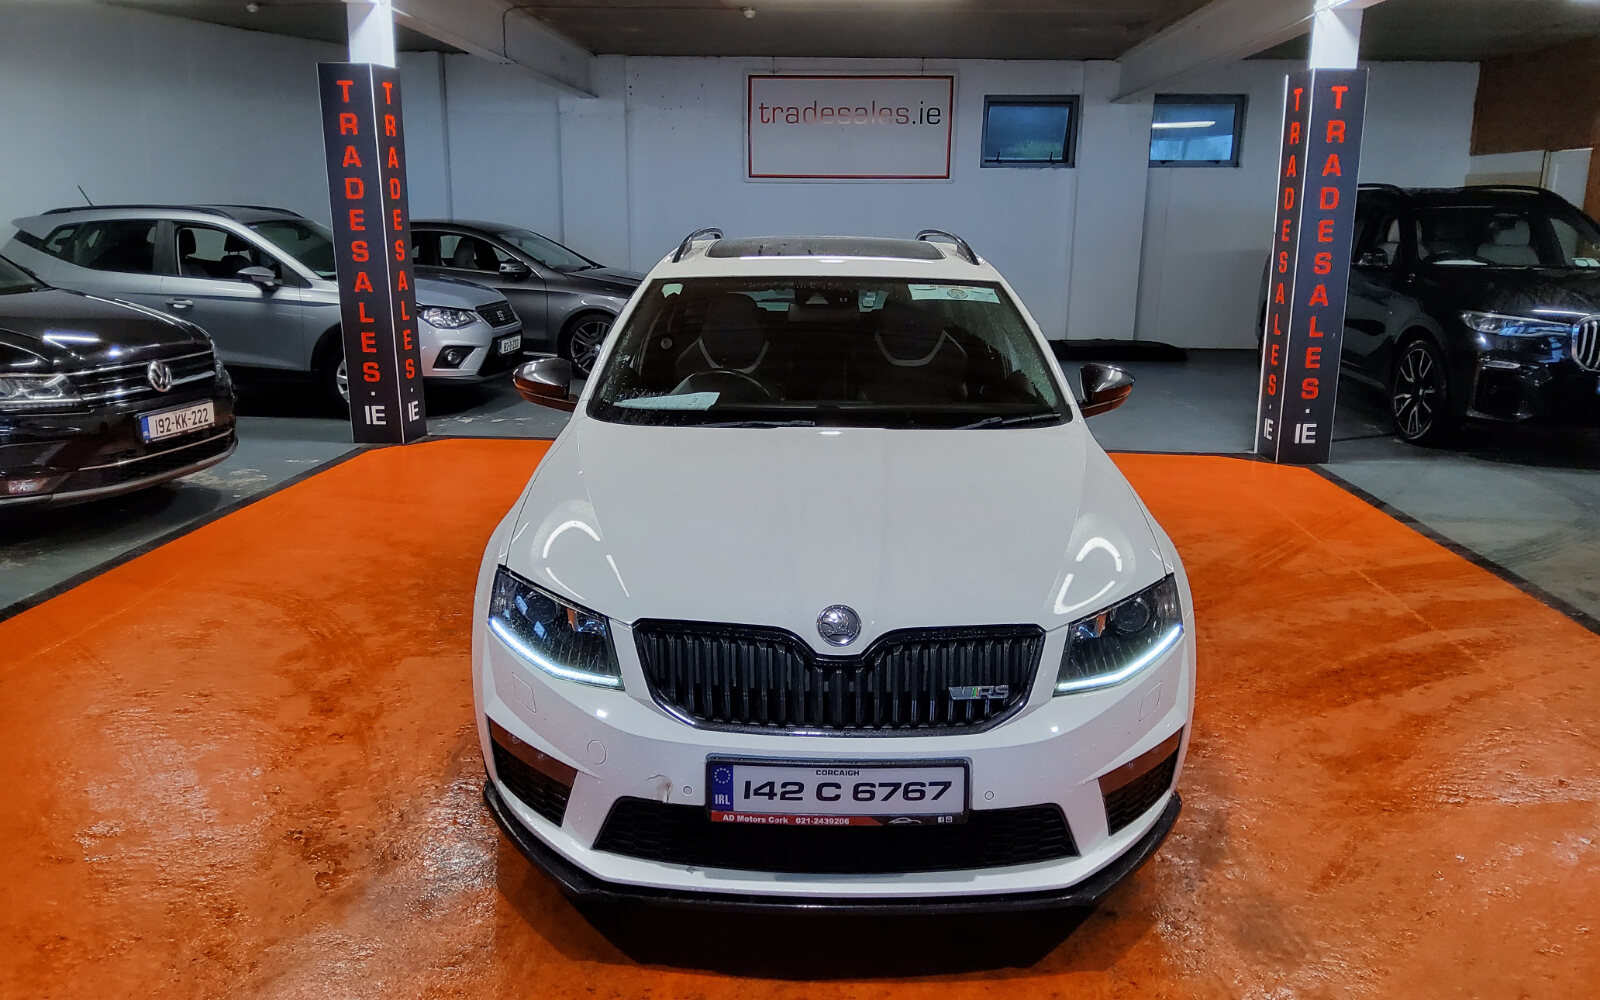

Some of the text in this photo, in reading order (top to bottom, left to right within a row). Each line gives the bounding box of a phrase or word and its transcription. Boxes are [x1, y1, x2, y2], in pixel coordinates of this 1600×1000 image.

[758, 100, 942, 125] tradesales.ie
[154, 407, 209, 436] 192-KK-222
[815, 769, 860, 777] CORCAIGH
[714, 793, 731, 806] IRL
[743, 780, 953, 802] 142 C 6767
[722, 814, 735, 822] AD
[736, 815, 766, 824] Motors
[768, 816, 789, 825] Cork
